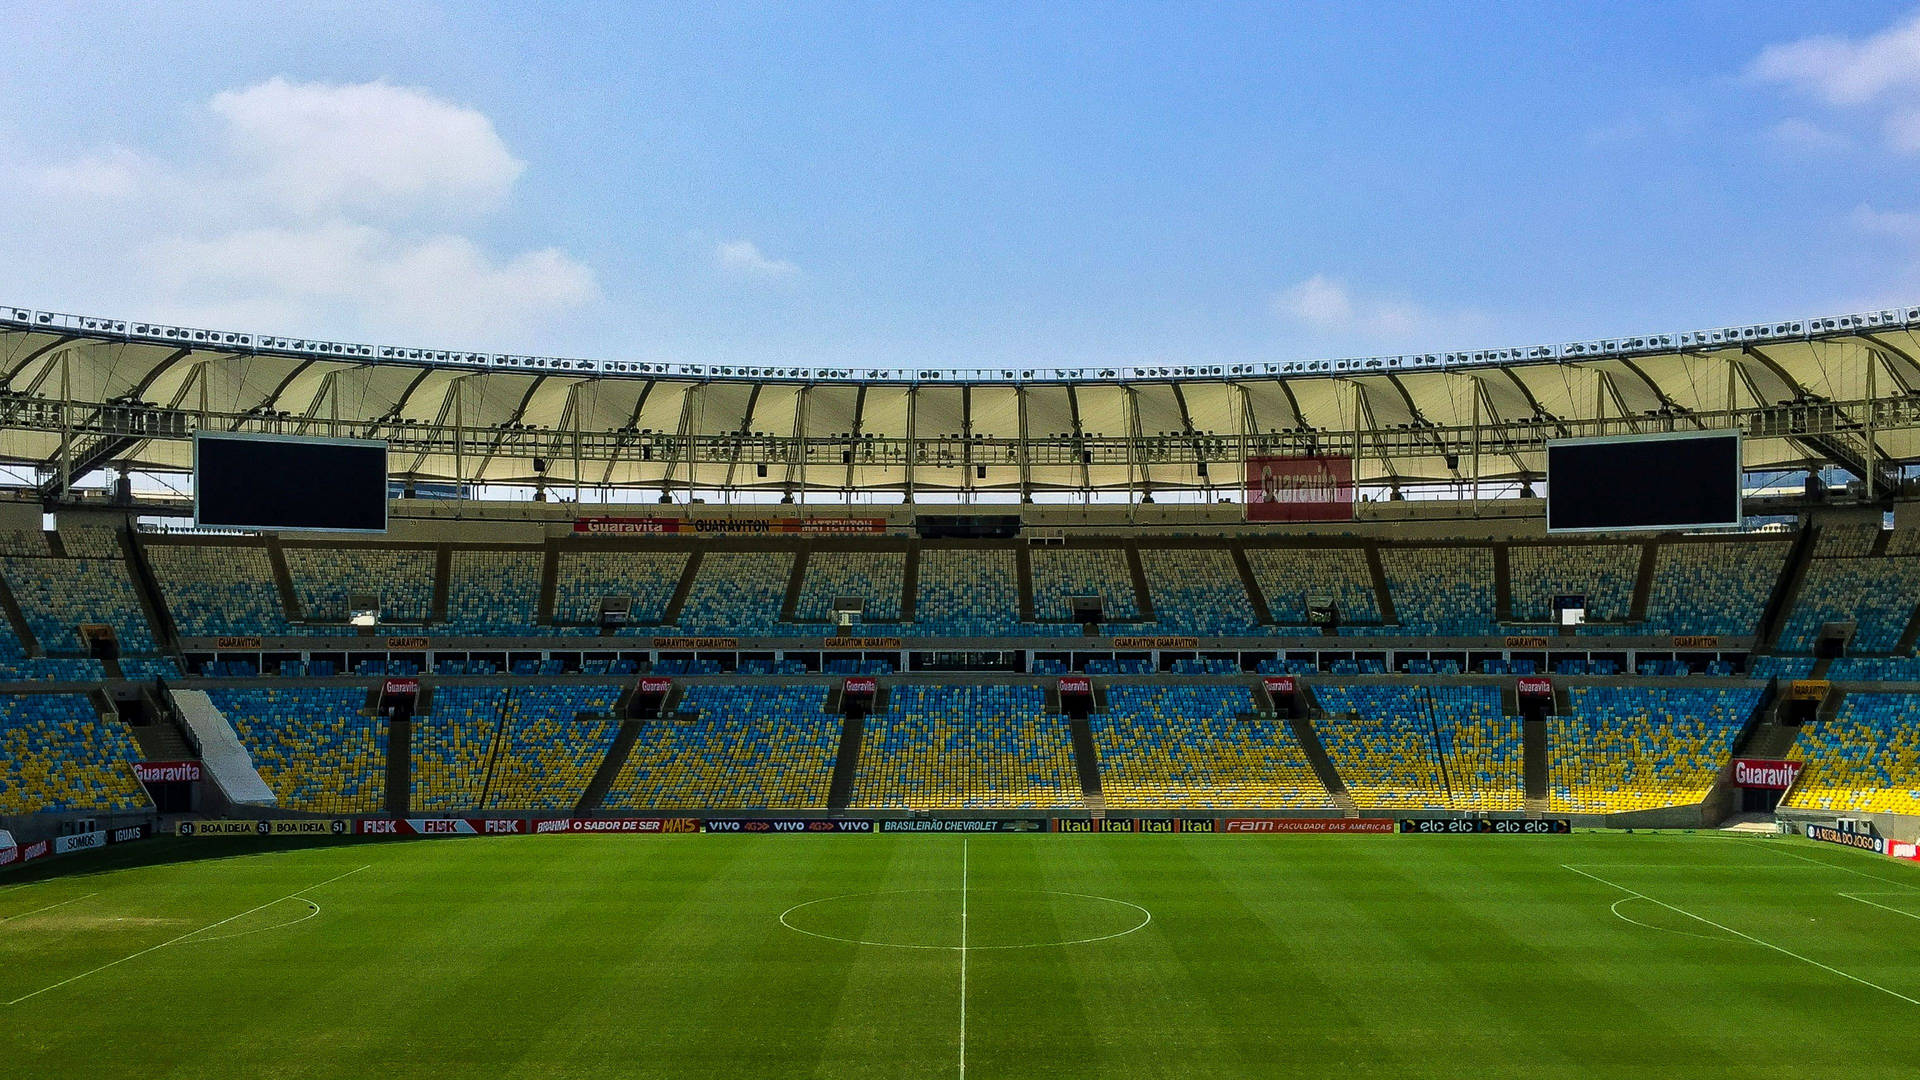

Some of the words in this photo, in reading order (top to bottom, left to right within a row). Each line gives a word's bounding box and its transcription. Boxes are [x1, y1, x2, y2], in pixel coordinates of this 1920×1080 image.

[1262, 465, 1337, 503] Guaravita
[587, 519, 663, 532] Guaravita
[695, 519, 770, 532] GUARAVITON
[218, 638, 261, 648] GUARAVITON
[389, 638, 428, 648] GUARAVITON
[653, 638, 694, 648] GUARAVITON
[695, 638, 737, 648] GUARAVITON
[825, 638, 862, 647] GUARAVITON
[1114, 638, 1155, 647] GUARAVITON
[1156, 638, 1198, 647] GUARAVITON
[1506, 638, 1547, 648] GUARAVITON
[1674, 638, 1717, 648] GUARAVITON
[386, 681, 418, 693] Guaravita
[1518, 680, 1551, 692] Guaravita
[134, 763, 200, 781] Guaravita
[201, 824, 222, 833] BOA
[225, 824, 251, 833] IDEIA
[277, 823, 298, 832] BOA
[300, 823, 325, 832] IDEIA
[363, 820, 397, 833] FISK
[425, 820, 458, 833] FISK
[485, 820, 519, 833] FISK
[574, 821, 583, 831] O
[584, 821, 620, 831] SABOR
[622, 821, 637, 831] DE
[638, 821, 660, 831] SER
[663, 818, 696, 834] MAIS
[884, 818, 944, 831] BRASILEIRÃO
[945, 820, 997, 831] CHEVROLET
[1061, 818, 1091, 832] Itaú
[1101, 818, 1132, 832] Itaú
[1141, 818, 1172, 832] Itaú
[1182, 818, 1213, 832] Itaú
[1278, 822, 1327, 831] FACULDADE
[1329, 822, 1346, 831] DAS
[1349, 820, 1392, 831] AMÉRICAS
[1420, 821, 1445, 833] elo
[1448, 821, 1473, 833] elo
[1495, 821, 1520, 833] elo
[1524, 821, 1549, 833] elo
[115, 826, 141, 843] IGUAIS
[68, 834, 96, 849] SOMOS
[1853, 834, 1874, 850] JOGO
